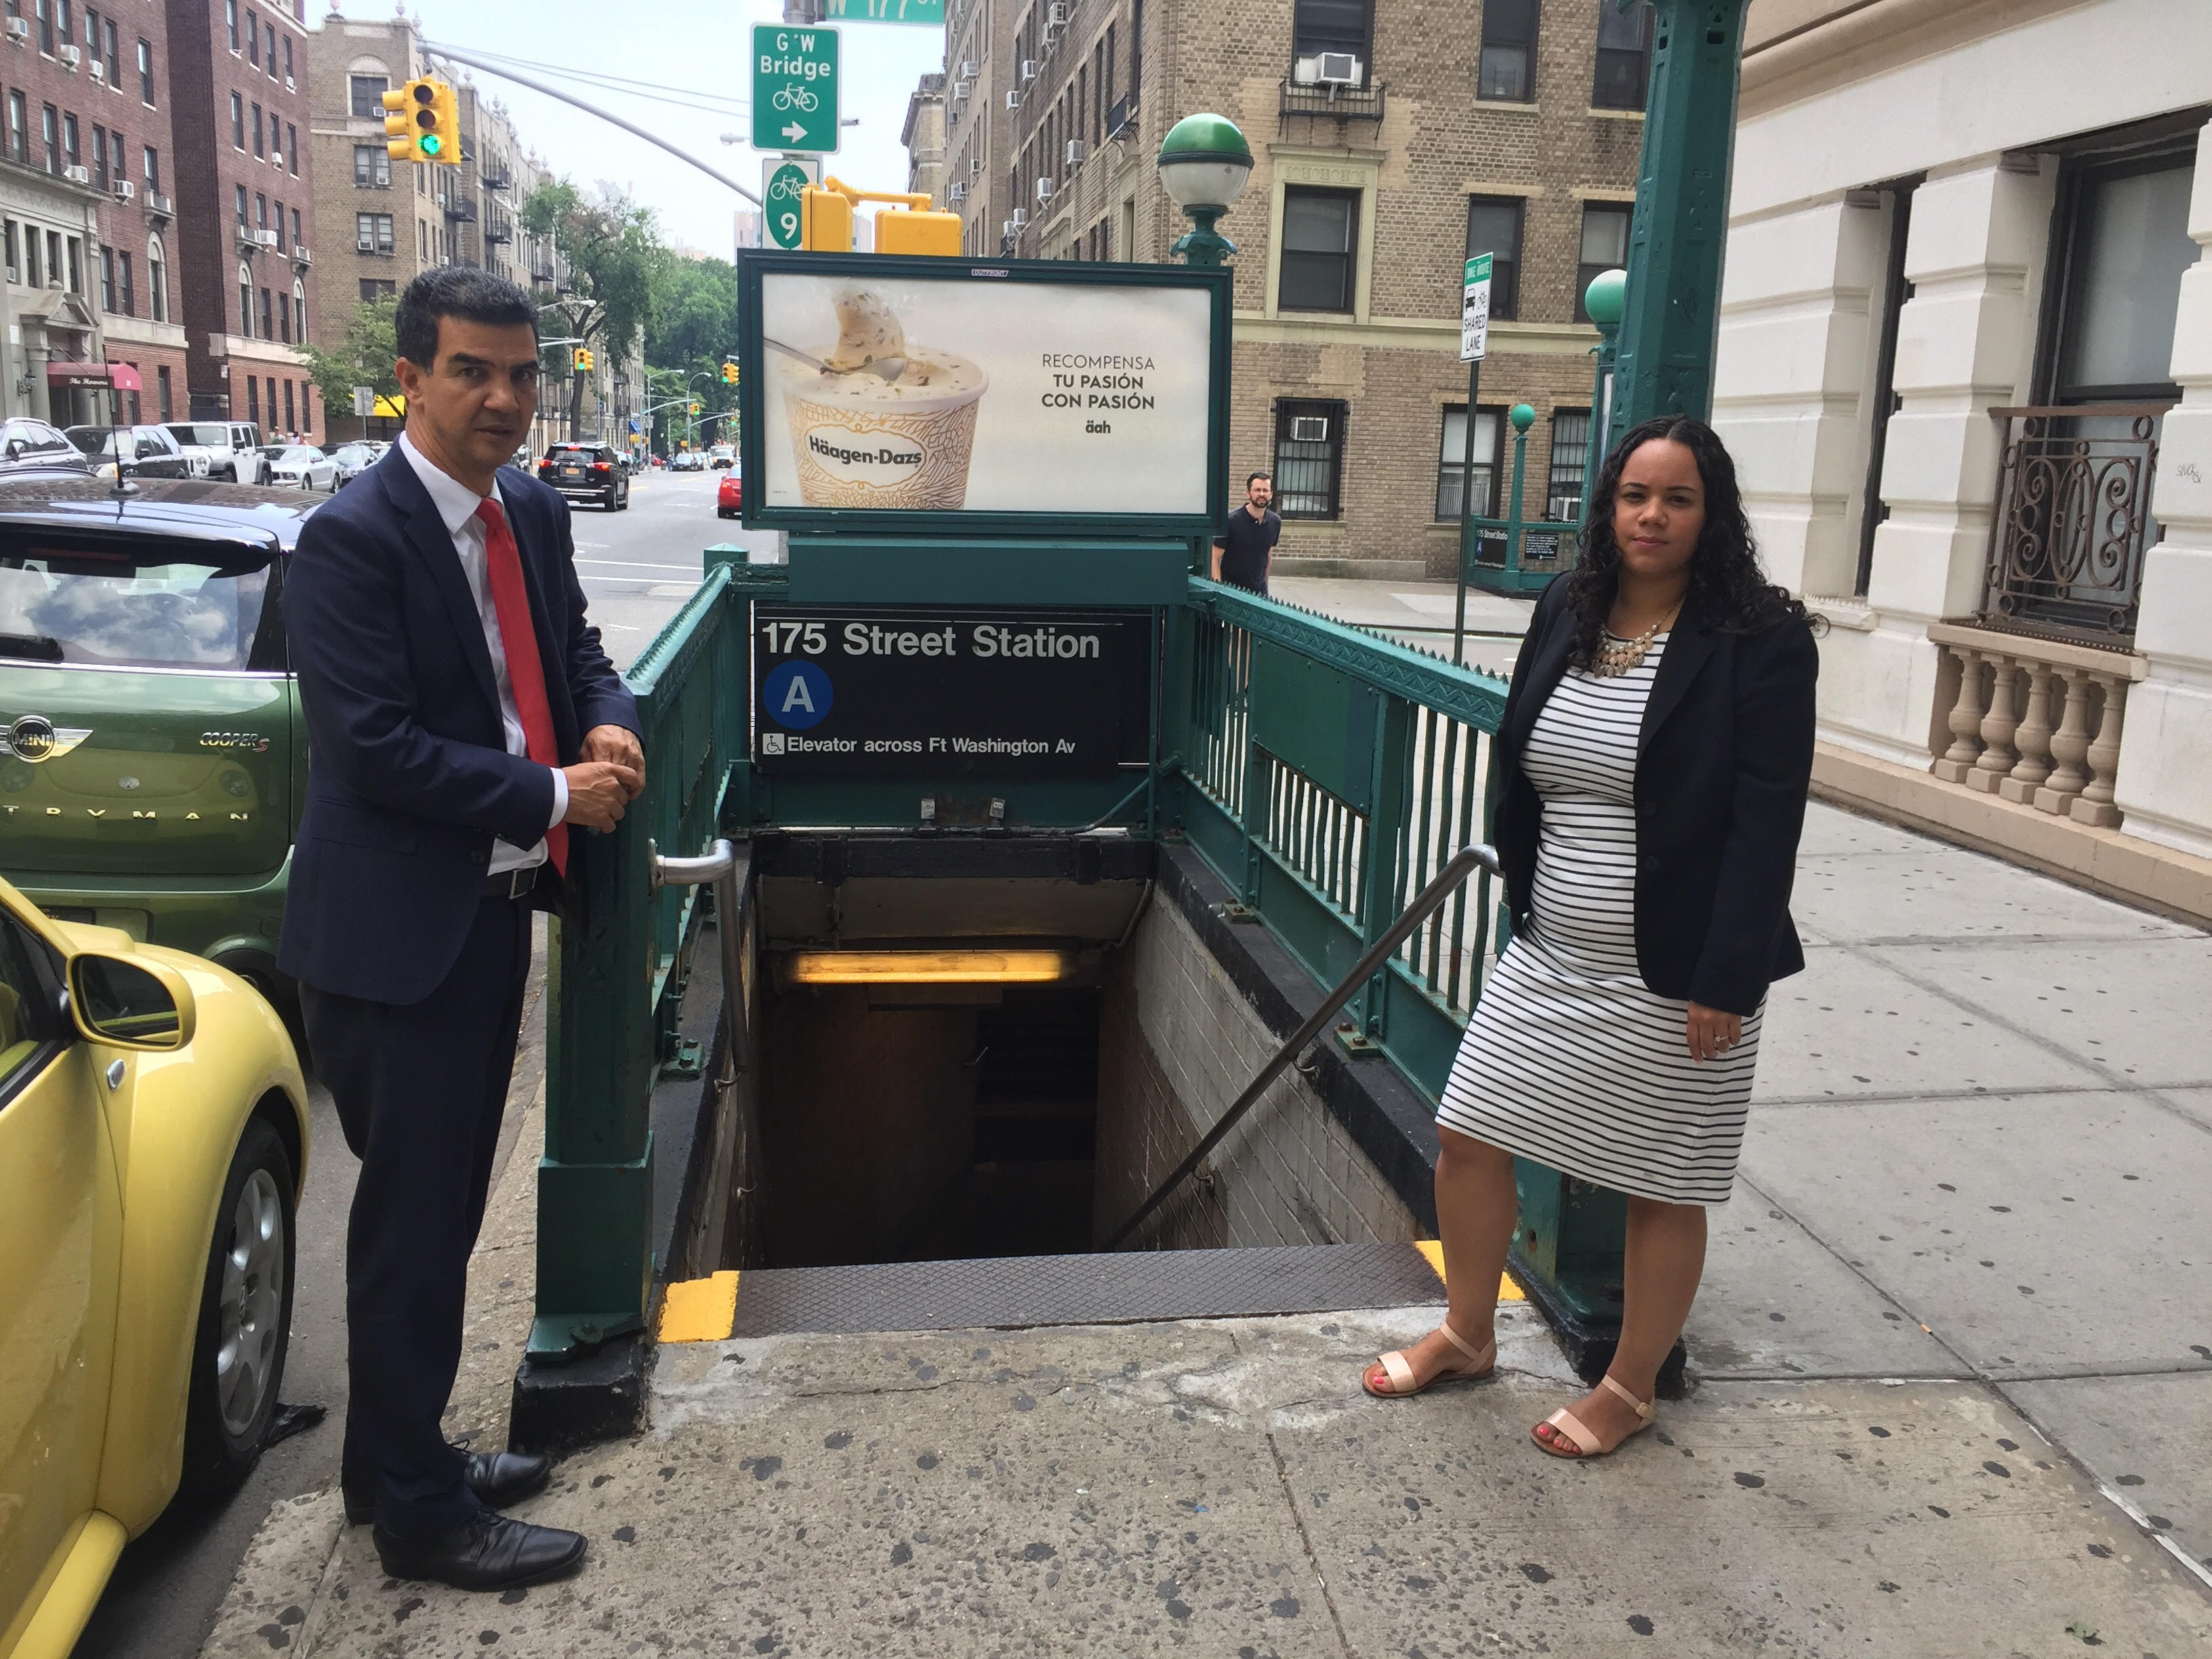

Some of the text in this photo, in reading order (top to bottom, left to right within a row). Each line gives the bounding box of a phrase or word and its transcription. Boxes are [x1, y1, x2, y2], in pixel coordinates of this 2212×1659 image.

[777, 33, 815, 53] G W
[760, 55, 831, 81] Bridge
[781, 212, 798, 241] 9
[1464, 314, 1486, 333] SHARED
[1466, 334, 1481, 352] LANE
[1042, 354, 1155, 370] RECOMPENSA
[1053, 372, 1143, 390] TU PASIÓN
[1042, 392, 1155, 410] CON PASIÓN
[1085, 419, 1111, 434] äah
[809, 434, 922, 465] Häagen-Dazs
[762, 621, 1100, 659] 175 Street Station
[781, 676, 815, 713] A
[14, 733, 51, 747] MINI
[787, 736, 1076, 756] Elevator across Ft Washington Av
